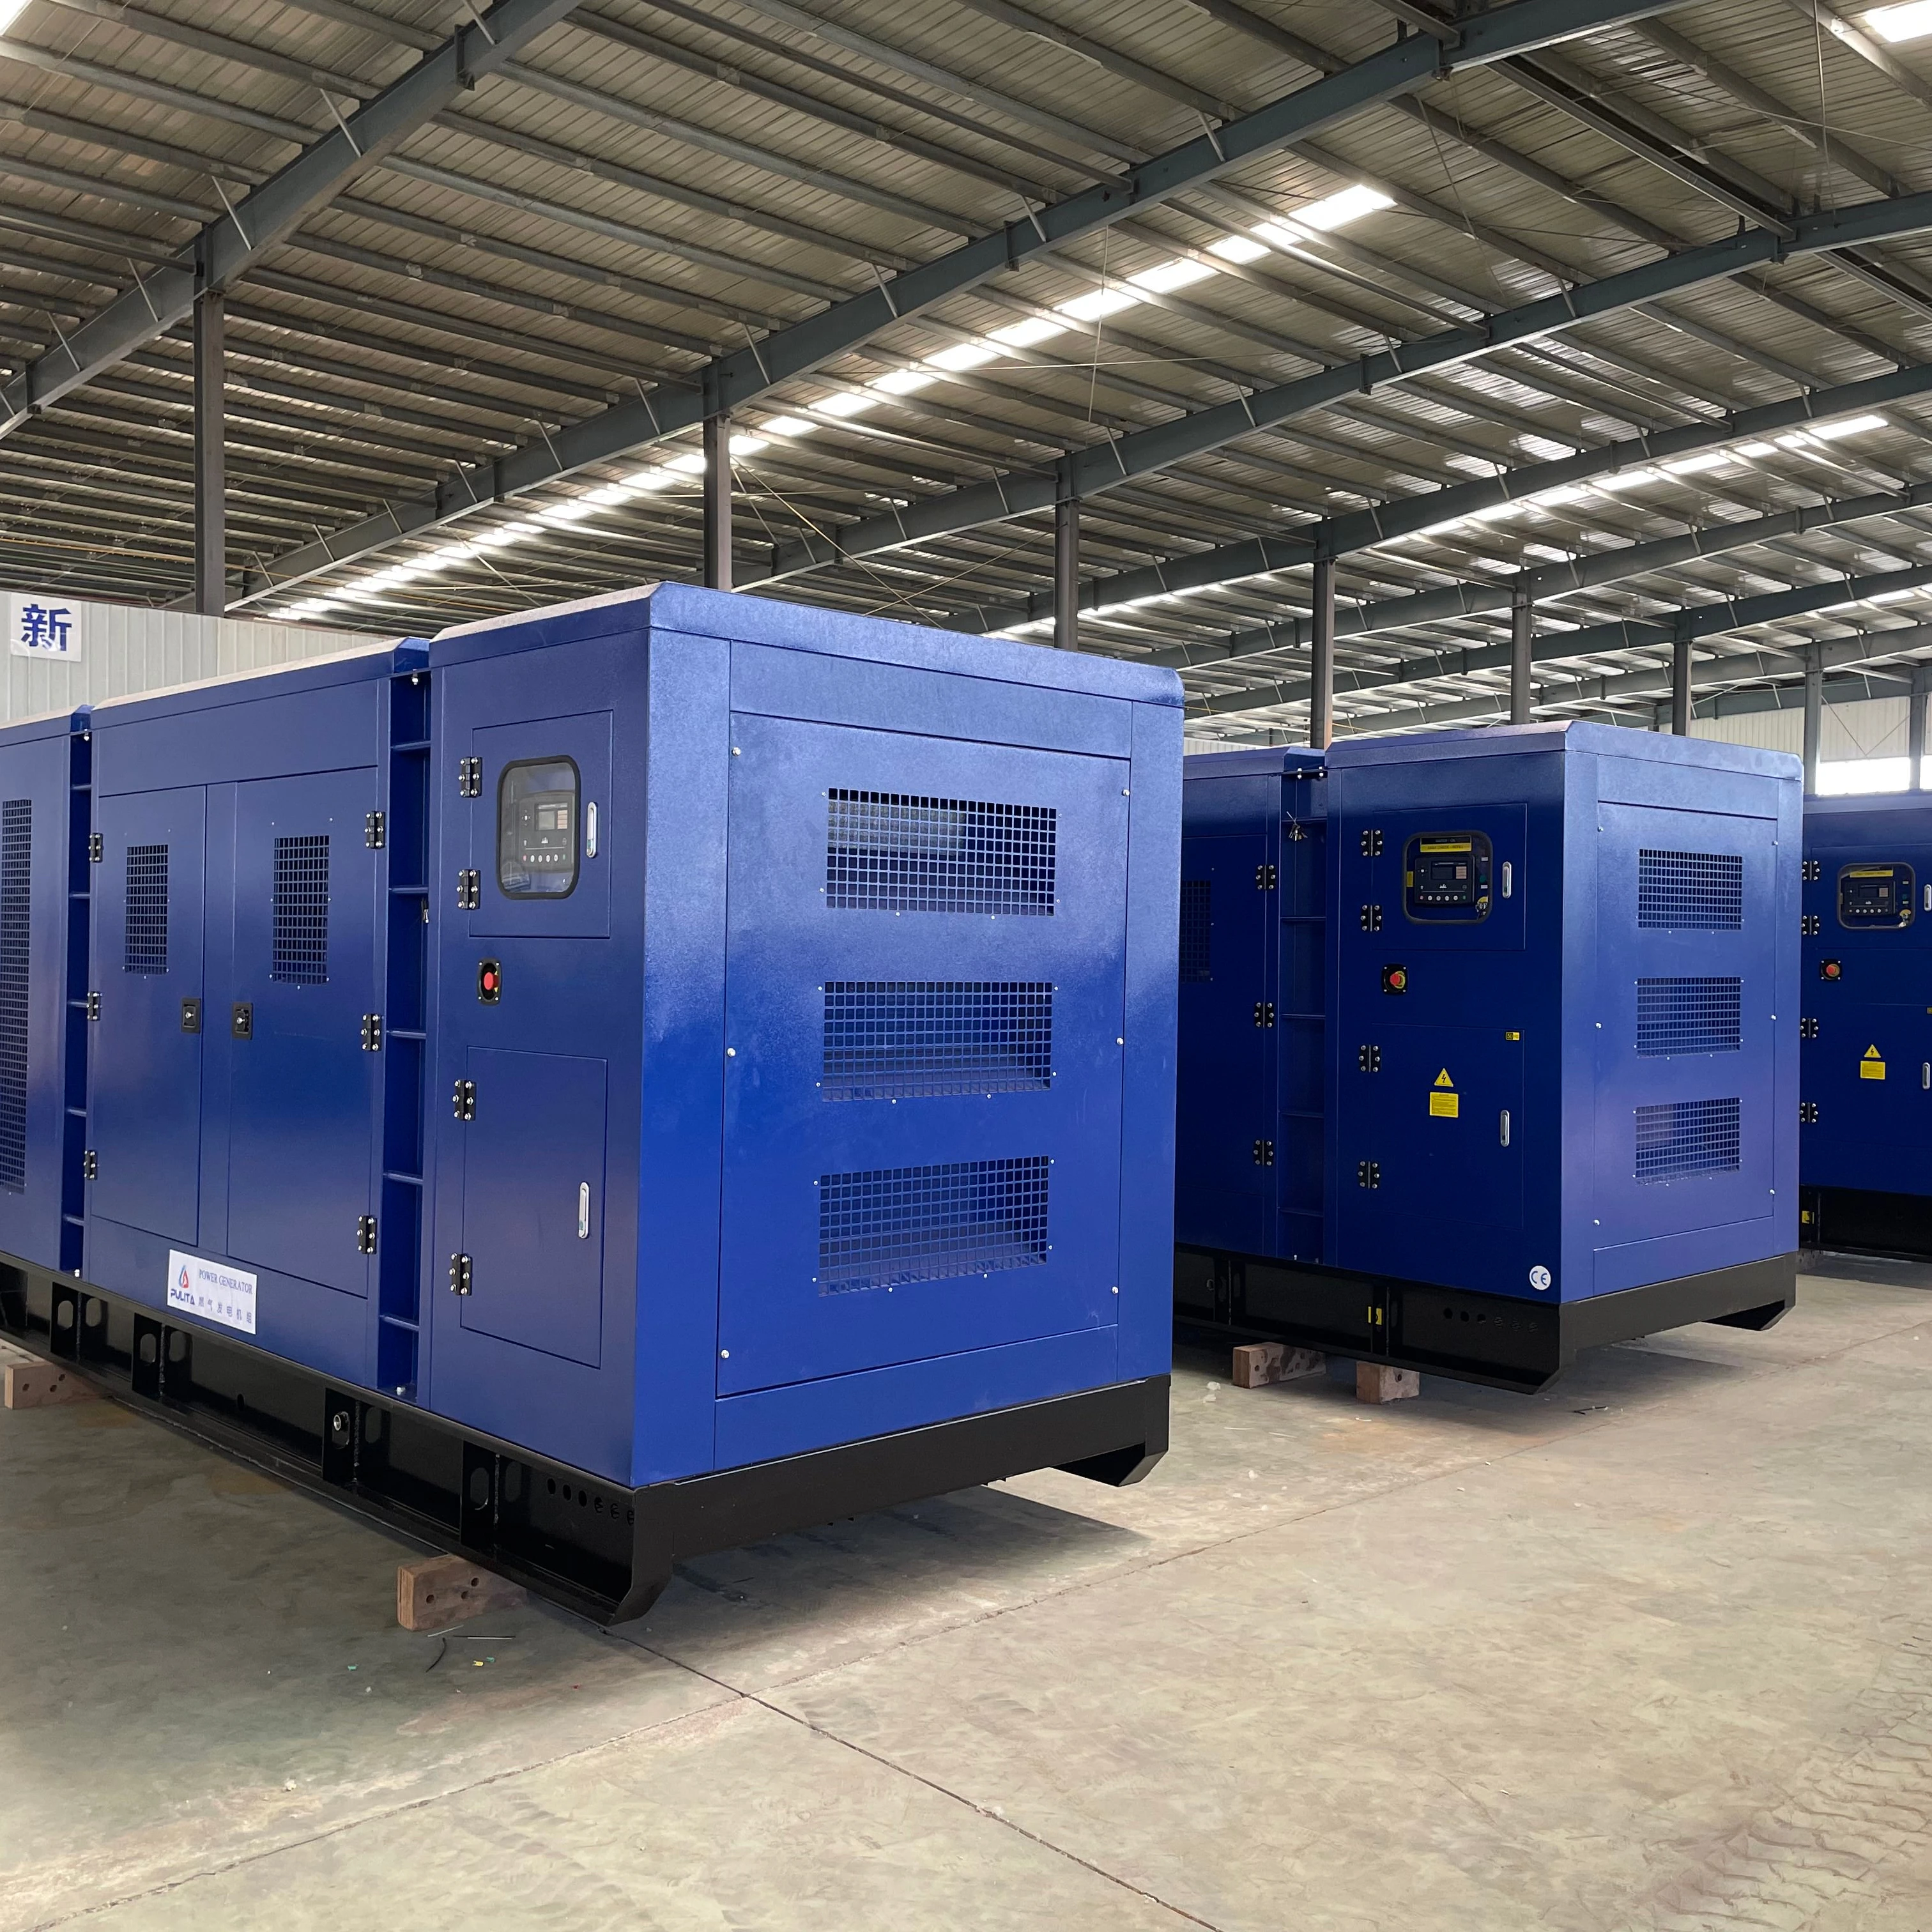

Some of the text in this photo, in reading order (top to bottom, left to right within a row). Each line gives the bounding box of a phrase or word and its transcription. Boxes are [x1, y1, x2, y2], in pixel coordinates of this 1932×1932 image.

[21, 603, 72, 652] 新
[199, 1269, 253, 1294] POWER GENERATOR
[1531, 1270, 1548, 1286] CE
[171, 1288, 195, 1305] PULITA
